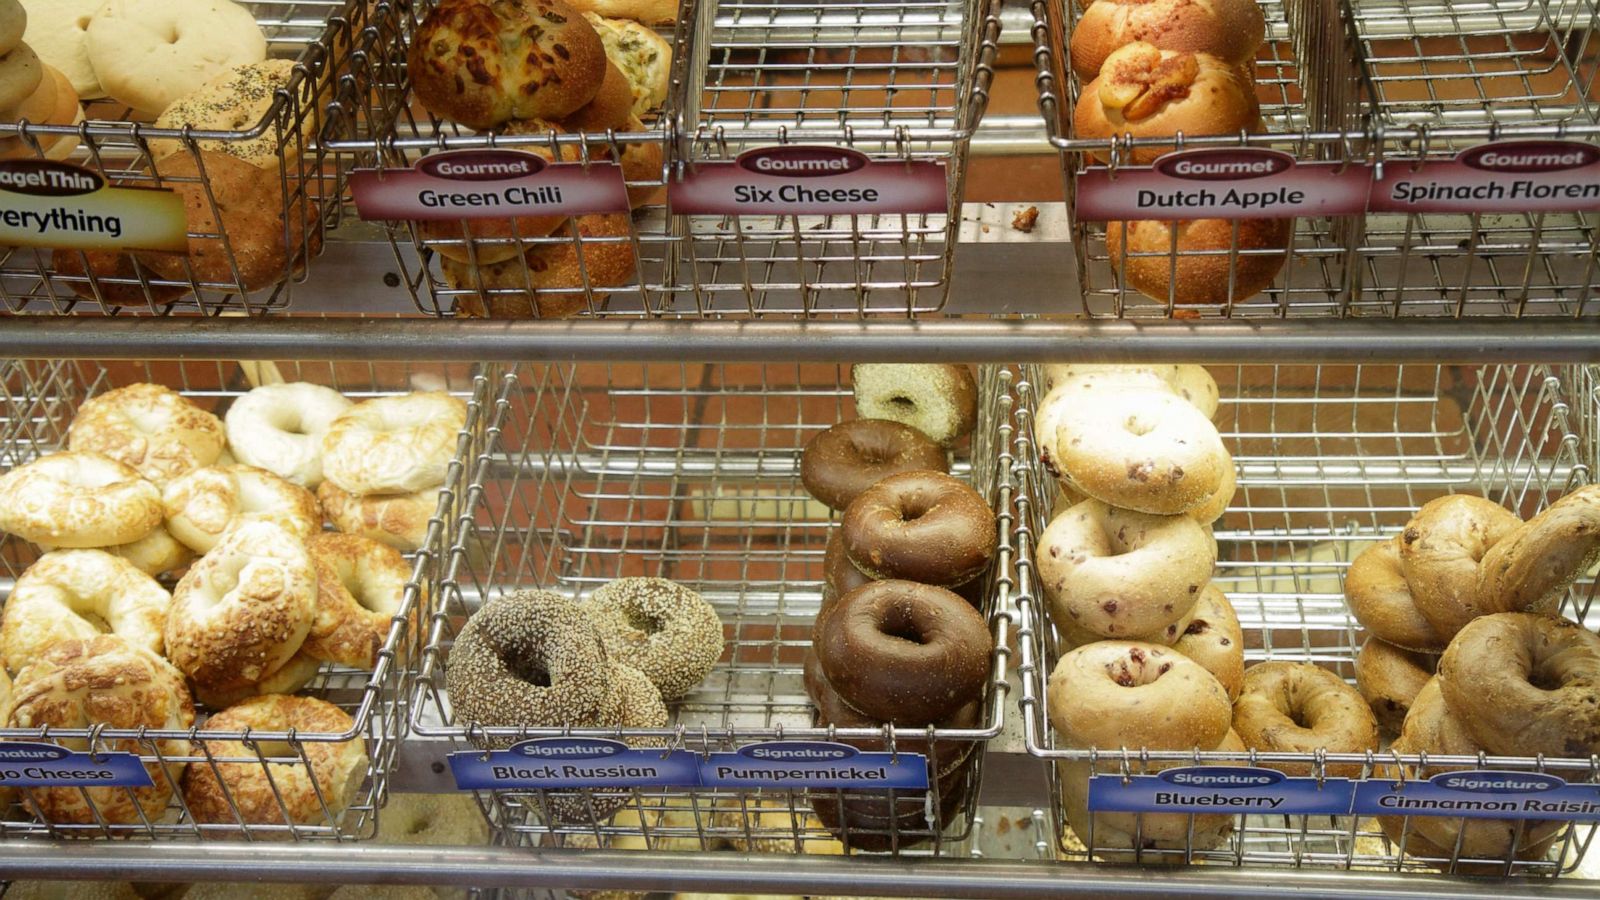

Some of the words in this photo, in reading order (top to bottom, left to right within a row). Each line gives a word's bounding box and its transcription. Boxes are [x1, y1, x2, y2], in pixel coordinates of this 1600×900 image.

[756, 156, 849, 170] Gourmet
[1479, 151, 1584, 166] Gourmet
[437, 160, 528, 175] Gourmet
[1175, 159, 1273, 175] Gourmet
[47, 170, 95, 190] Thin
[418, 190, 500, 207] Green
[504, 186, 562, 205] Chili
[734, 185, 775, 203] Six
[778, 185, 879, 202] Cheese
[1137, 189, 1216, 208] Dutch
[1221, 187, 1305, 208] Apple
[1393, 181, 1504, 204] Spinach
[1510, 180, 1600, 198] Floren
[0, 208, 122, 237] erything
[523, 744, 615, 756] Signature
[753, 748, 845, 759] Signature
[23, 767, 113, 780] Cheese
[493, 766, 559, 780] Black
[564, 765, 657, 779] Russian
[717, 766, 887, 781] Pumpernickel
[1173, 773, 1271, 784] Signature
[1447, 778, 1549, 790] Signature
[1155, 792, 1285, 808] Blueberry
[1379, 795, 1517, 812] Cinnamon
